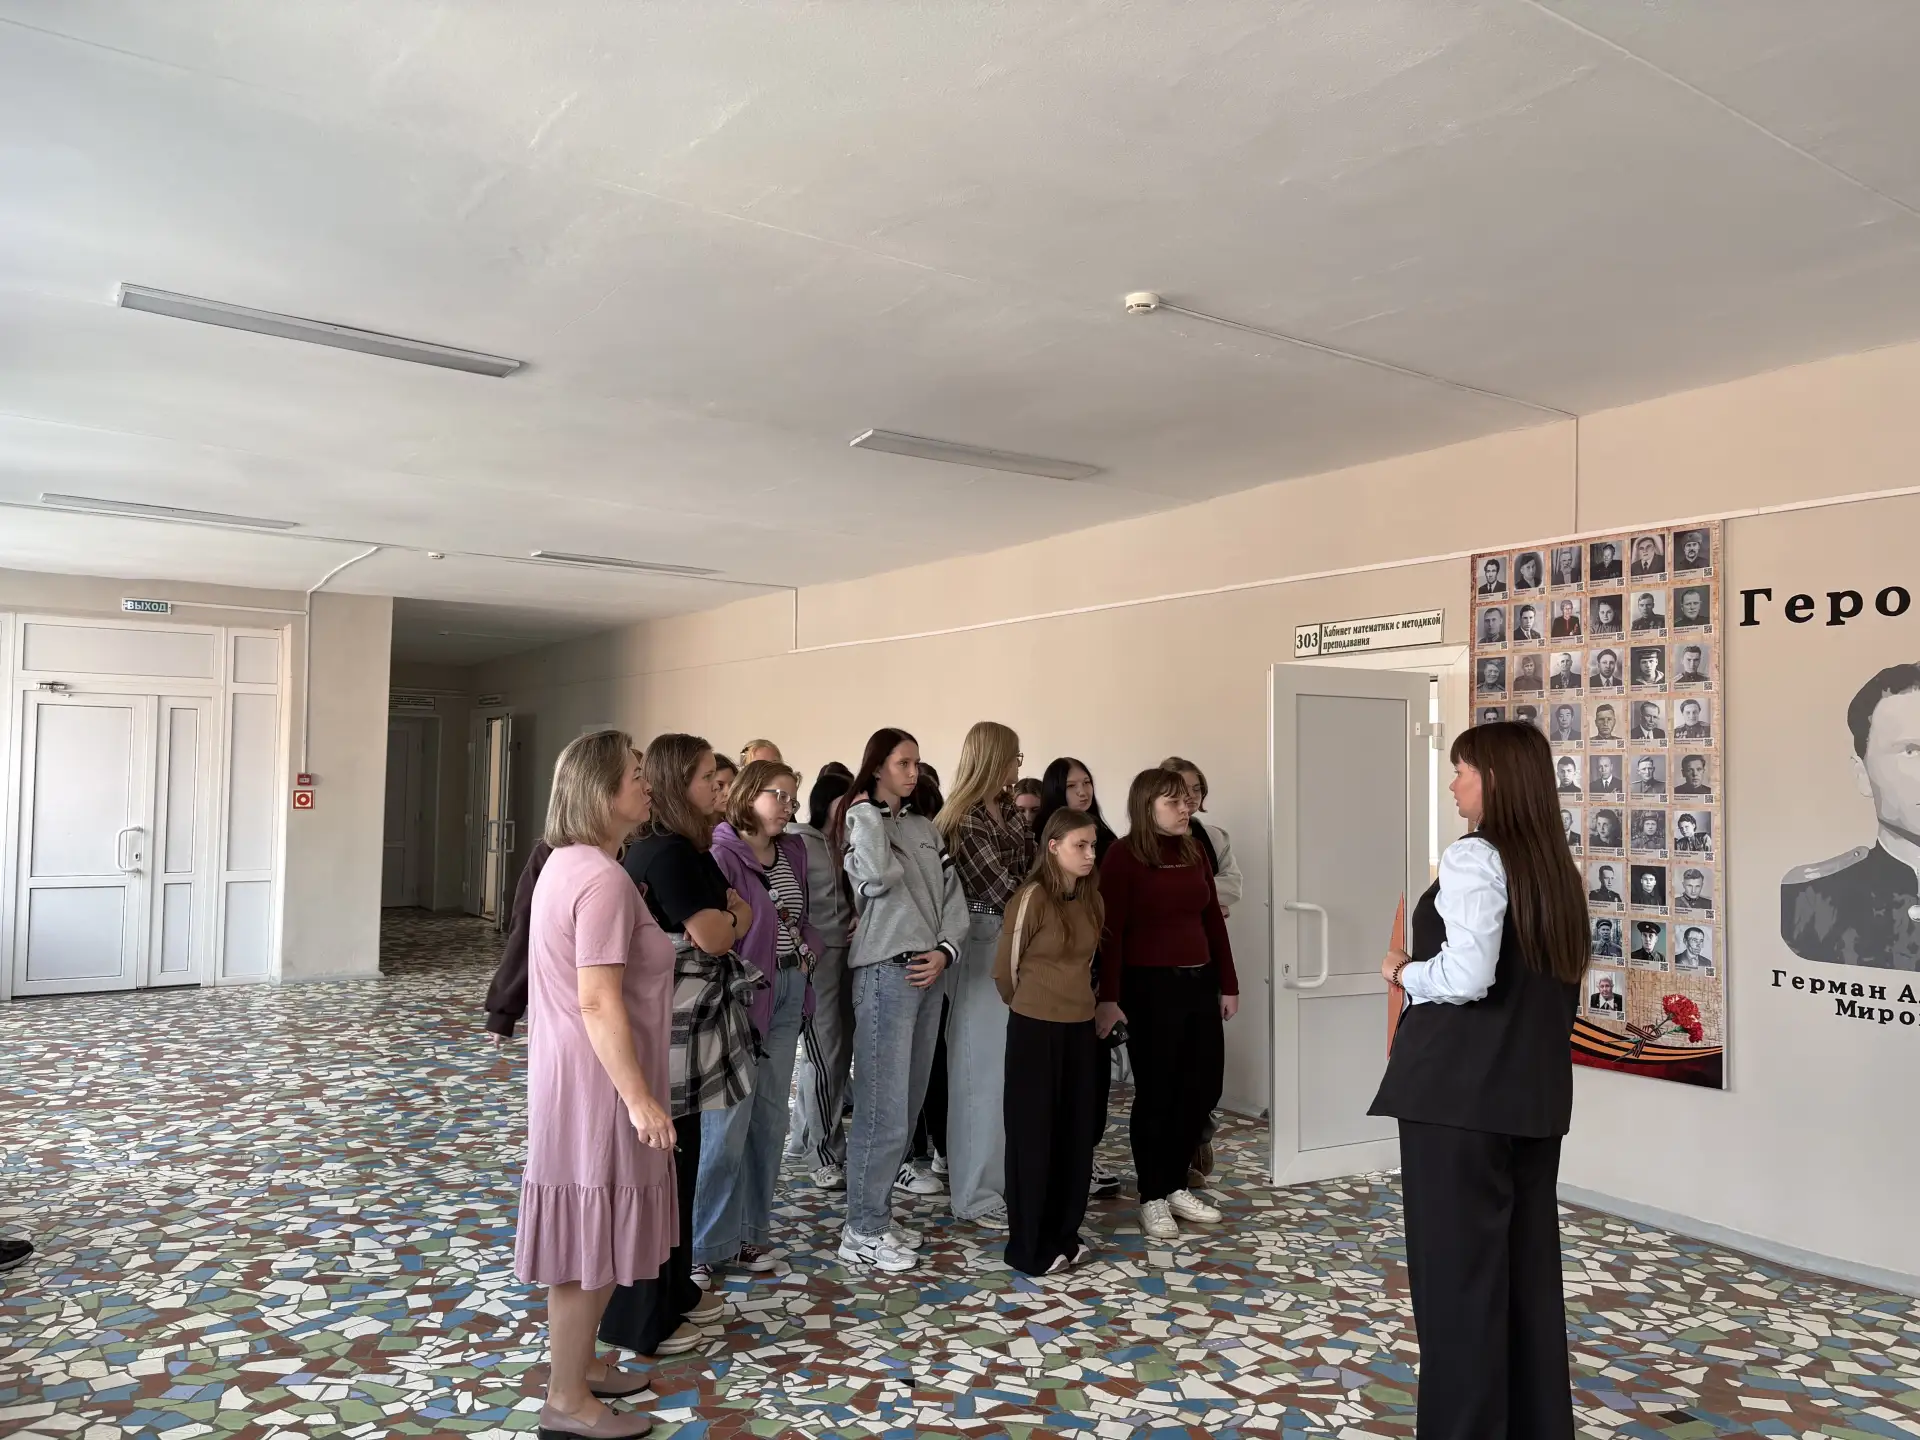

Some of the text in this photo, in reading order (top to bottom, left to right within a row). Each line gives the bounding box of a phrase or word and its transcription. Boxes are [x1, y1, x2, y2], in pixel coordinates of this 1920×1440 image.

[128, 601, 166, 611] ВЫХОД
[1323, 626, 1351, 637] Кабинет
[1353, 622, 1394, 633] математики
[1402, 614, 1440, 628] методикой
[1297, 633, 1318, 649] 303
[1323, 637, 1370, 652] преподавания
[1772, 970, 1920, 1004] Герман А
[1835, 998, 1920, 1027] Миро
